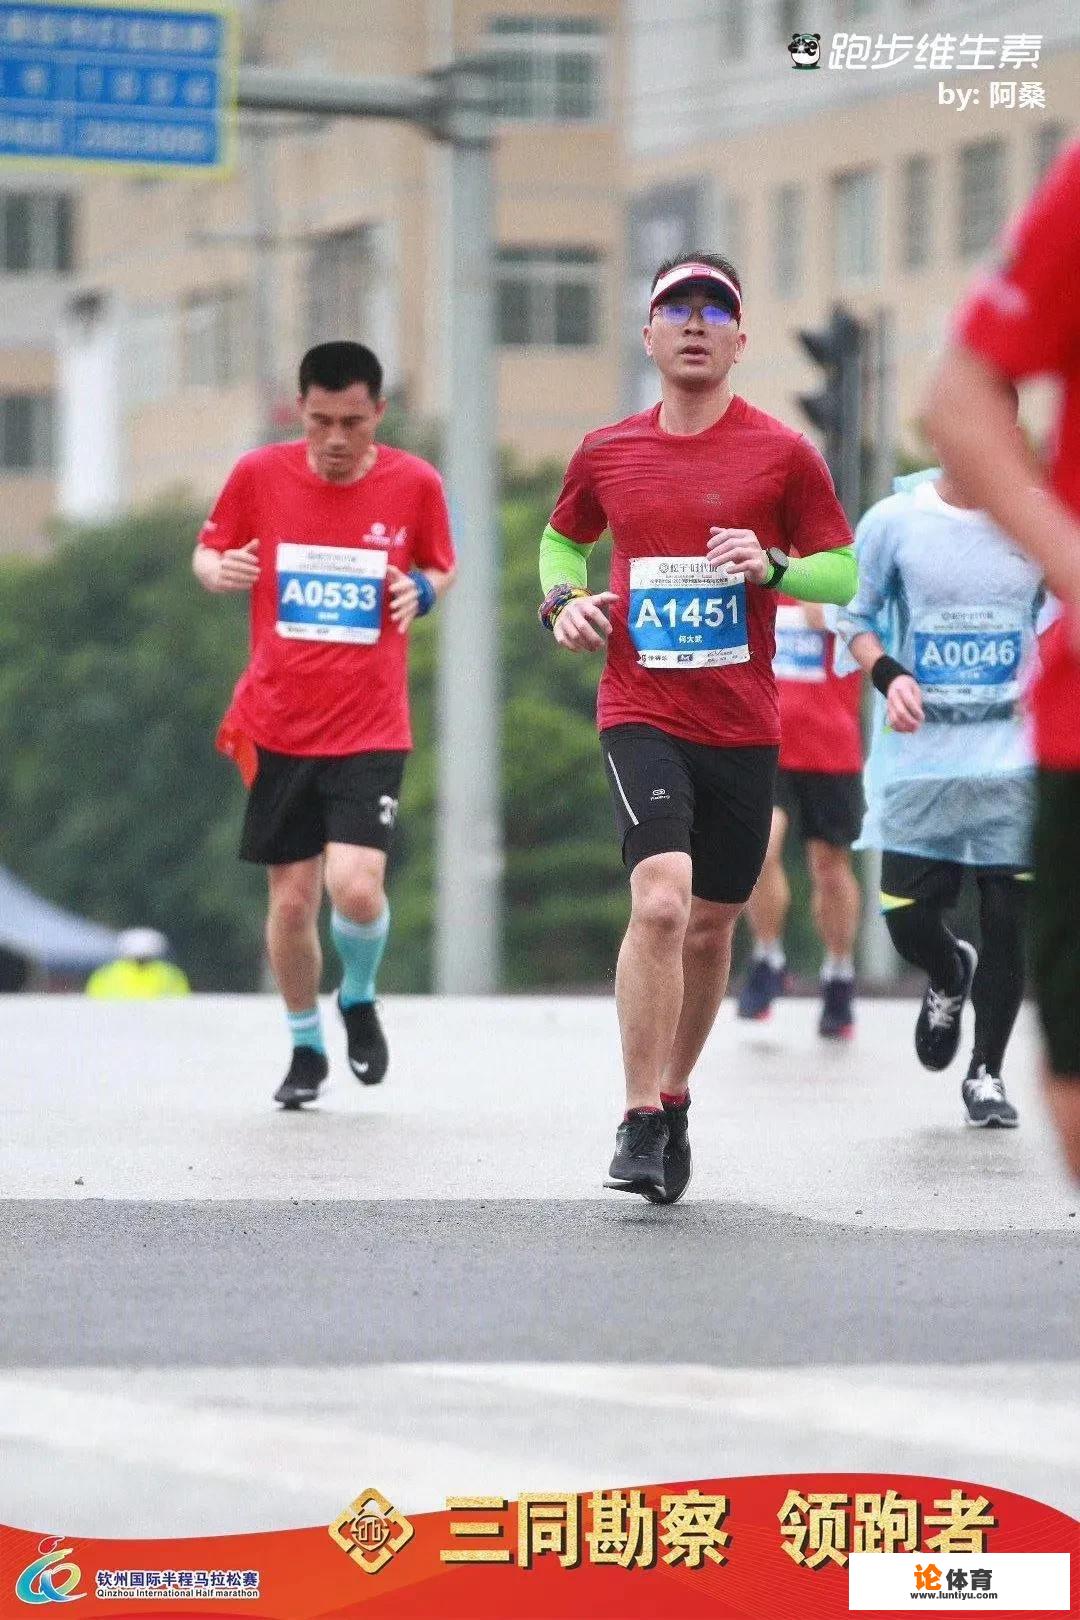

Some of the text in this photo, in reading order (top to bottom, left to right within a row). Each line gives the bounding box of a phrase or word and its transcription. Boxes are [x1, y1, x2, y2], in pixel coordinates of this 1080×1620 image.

[281, 578, 377, 611] A0533
[634, 594, 738, 628] A1451
[919, 639, 1016, 668] A0046
